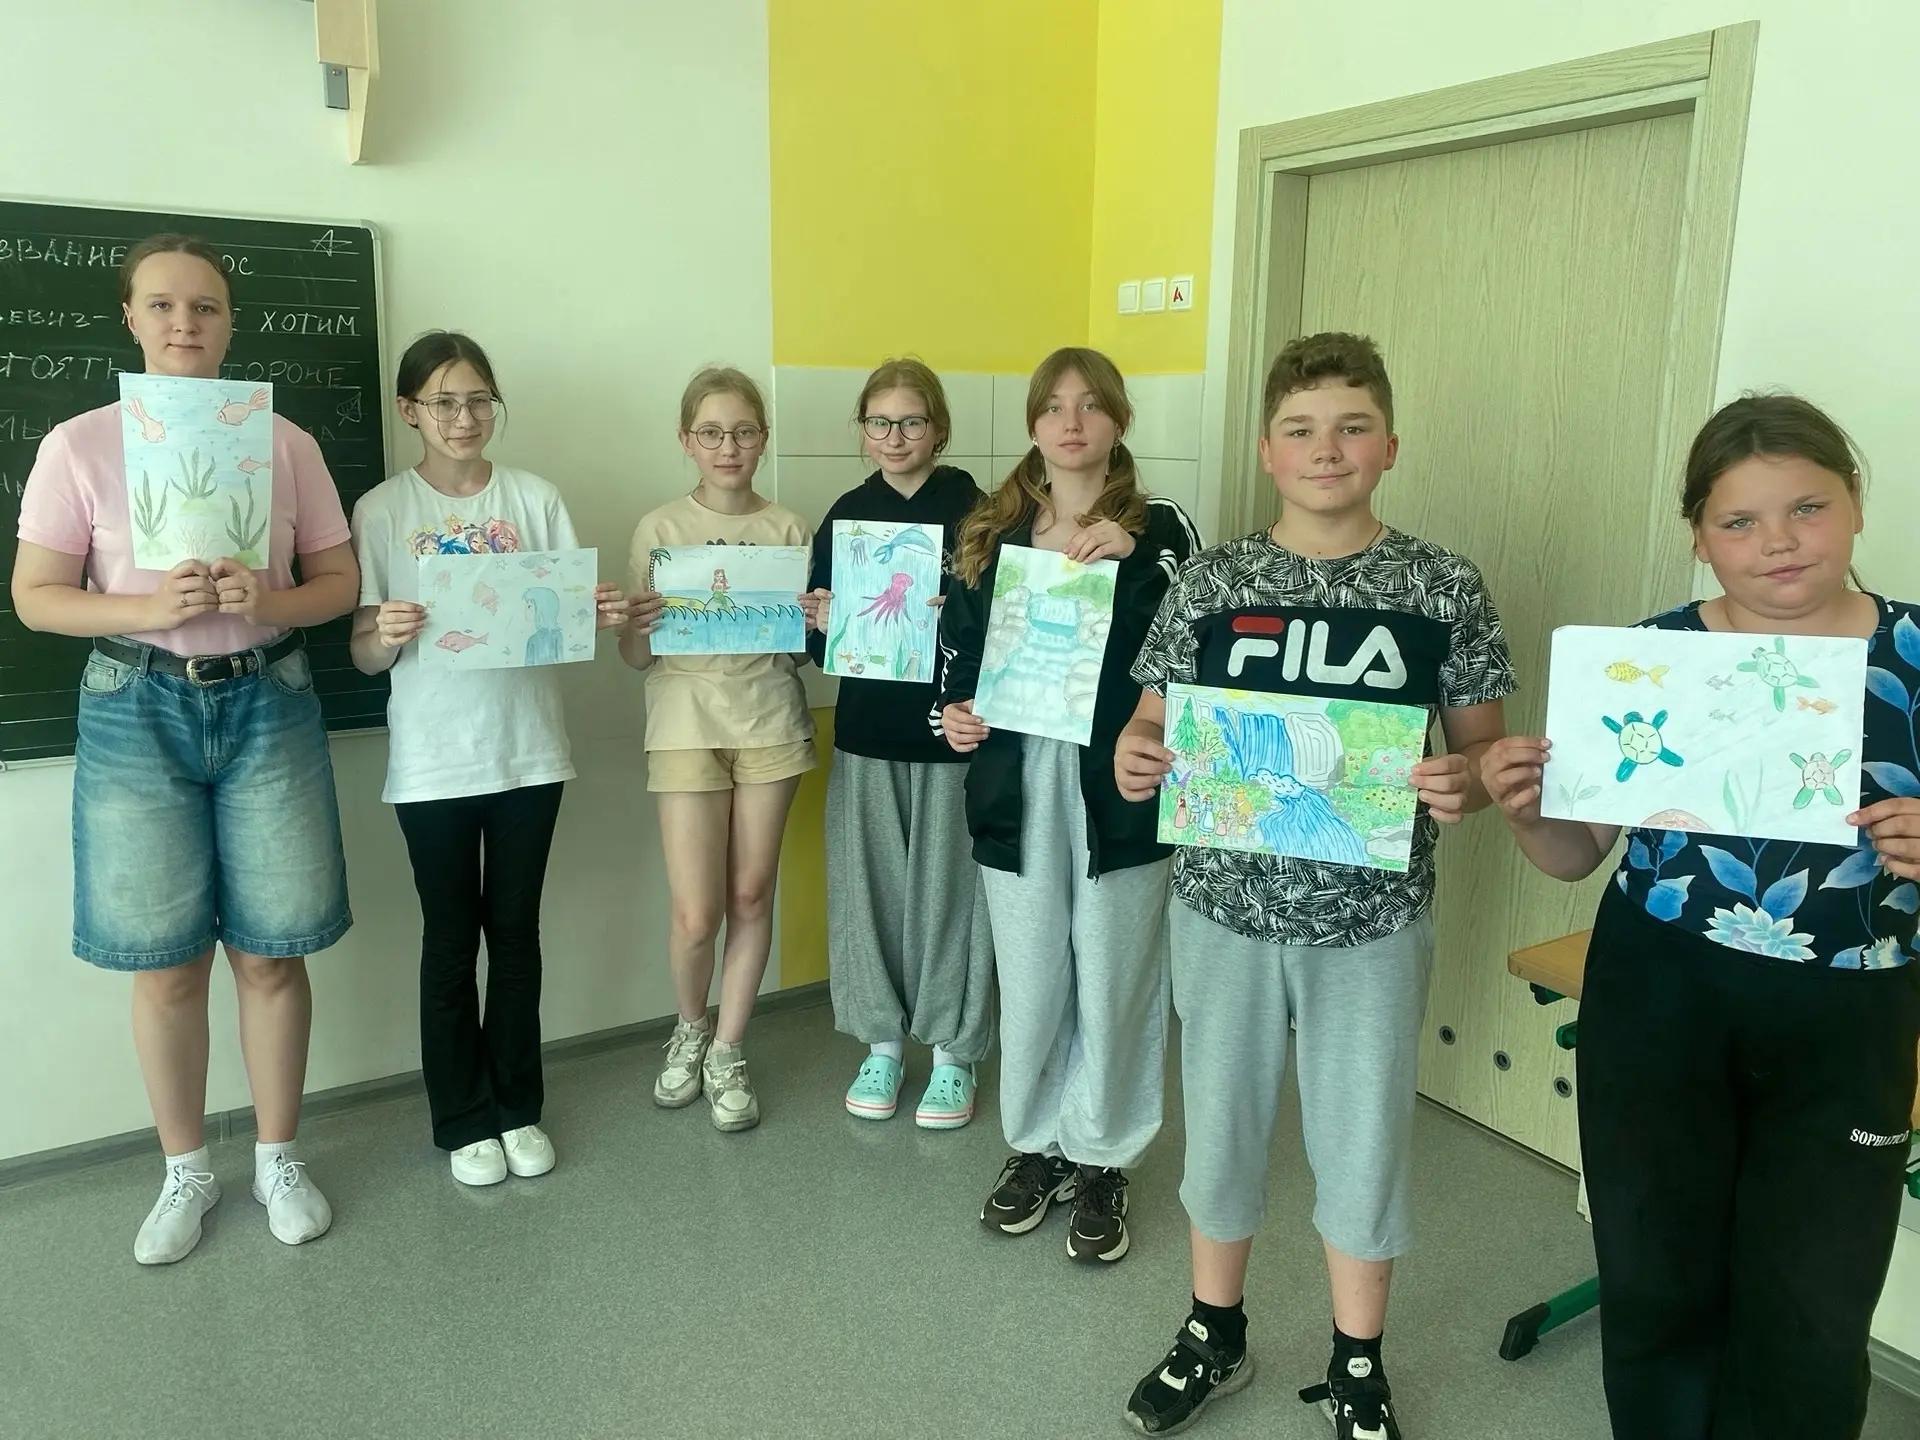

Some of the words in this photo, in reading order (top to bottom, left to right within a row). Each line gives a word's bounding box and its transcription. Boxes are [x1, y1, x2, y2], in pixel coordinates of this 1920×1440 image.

[0, 309, 111, 328] ЕВИЗ-
[260, 310, 356, 335] ХОТИМ
[0, 352, 127, 380] ТОЯТЬ
[221, 361, 345, 389] ТОРОНЕ
[1227, 615, 1408, 690] FILA
